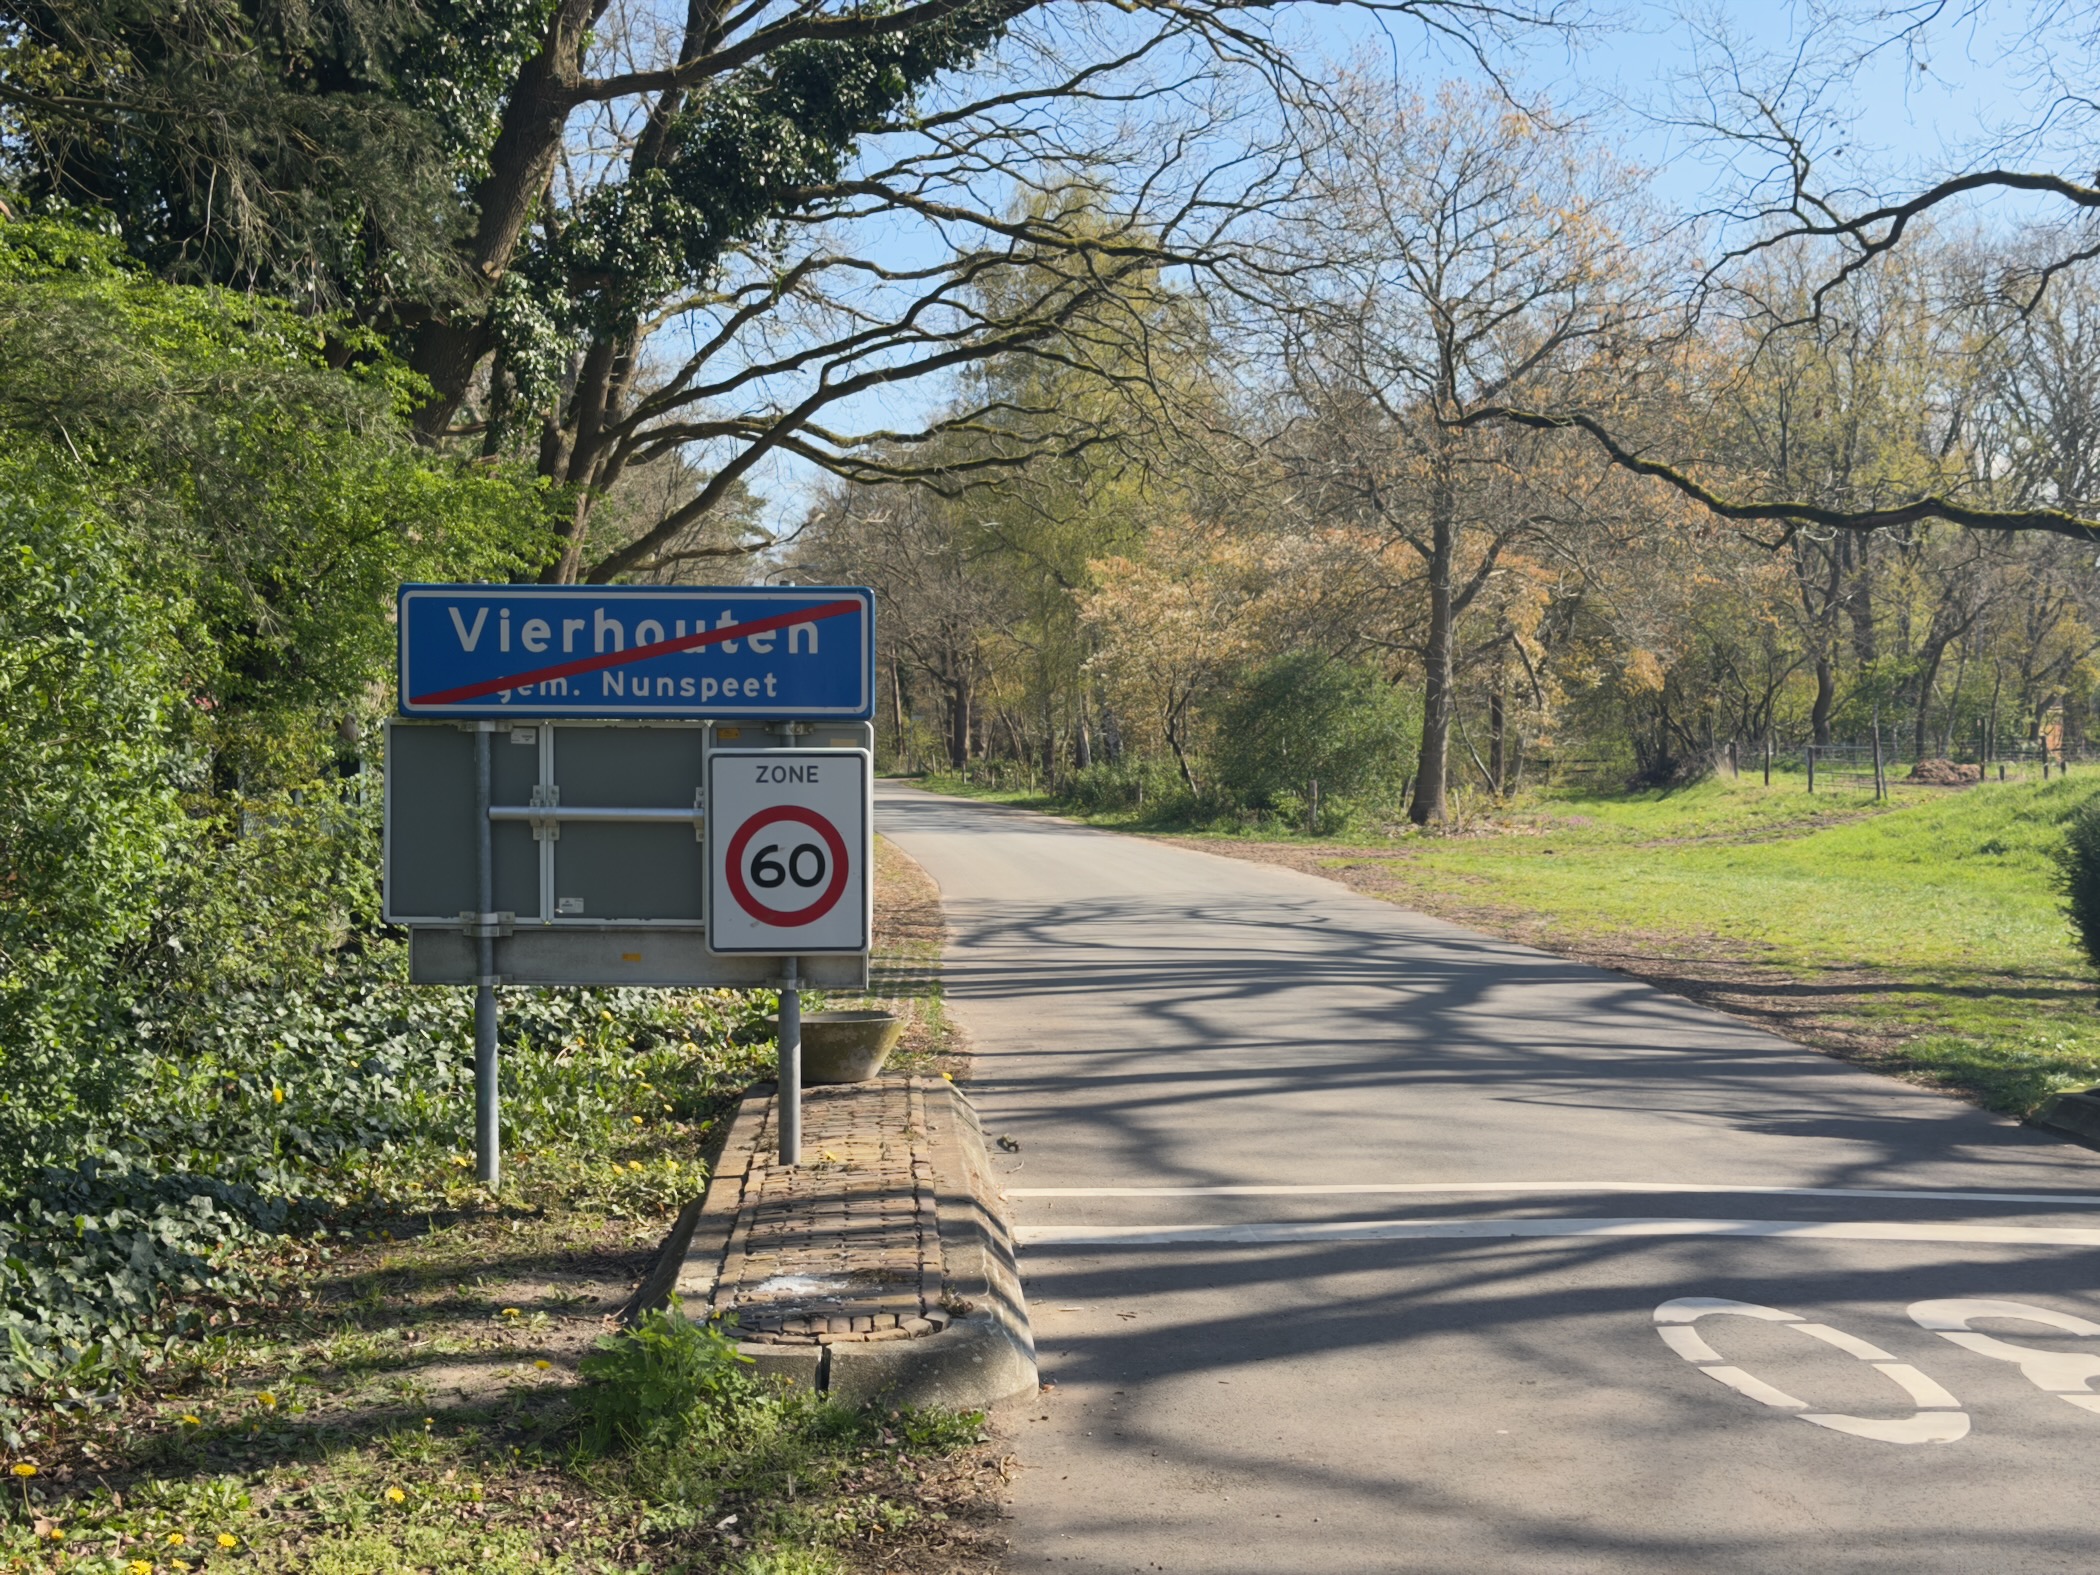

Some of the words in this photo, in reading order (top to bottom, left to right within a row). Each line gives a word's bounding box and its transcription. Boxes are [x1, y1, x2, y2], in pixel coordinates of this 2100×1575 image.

[448, 607, 819, 654] Vierhouten
[602, 670, 778, 703] Nunspeet
[755, 765, 819, 783] ZONE
[750, 843, 826, 888] 60
